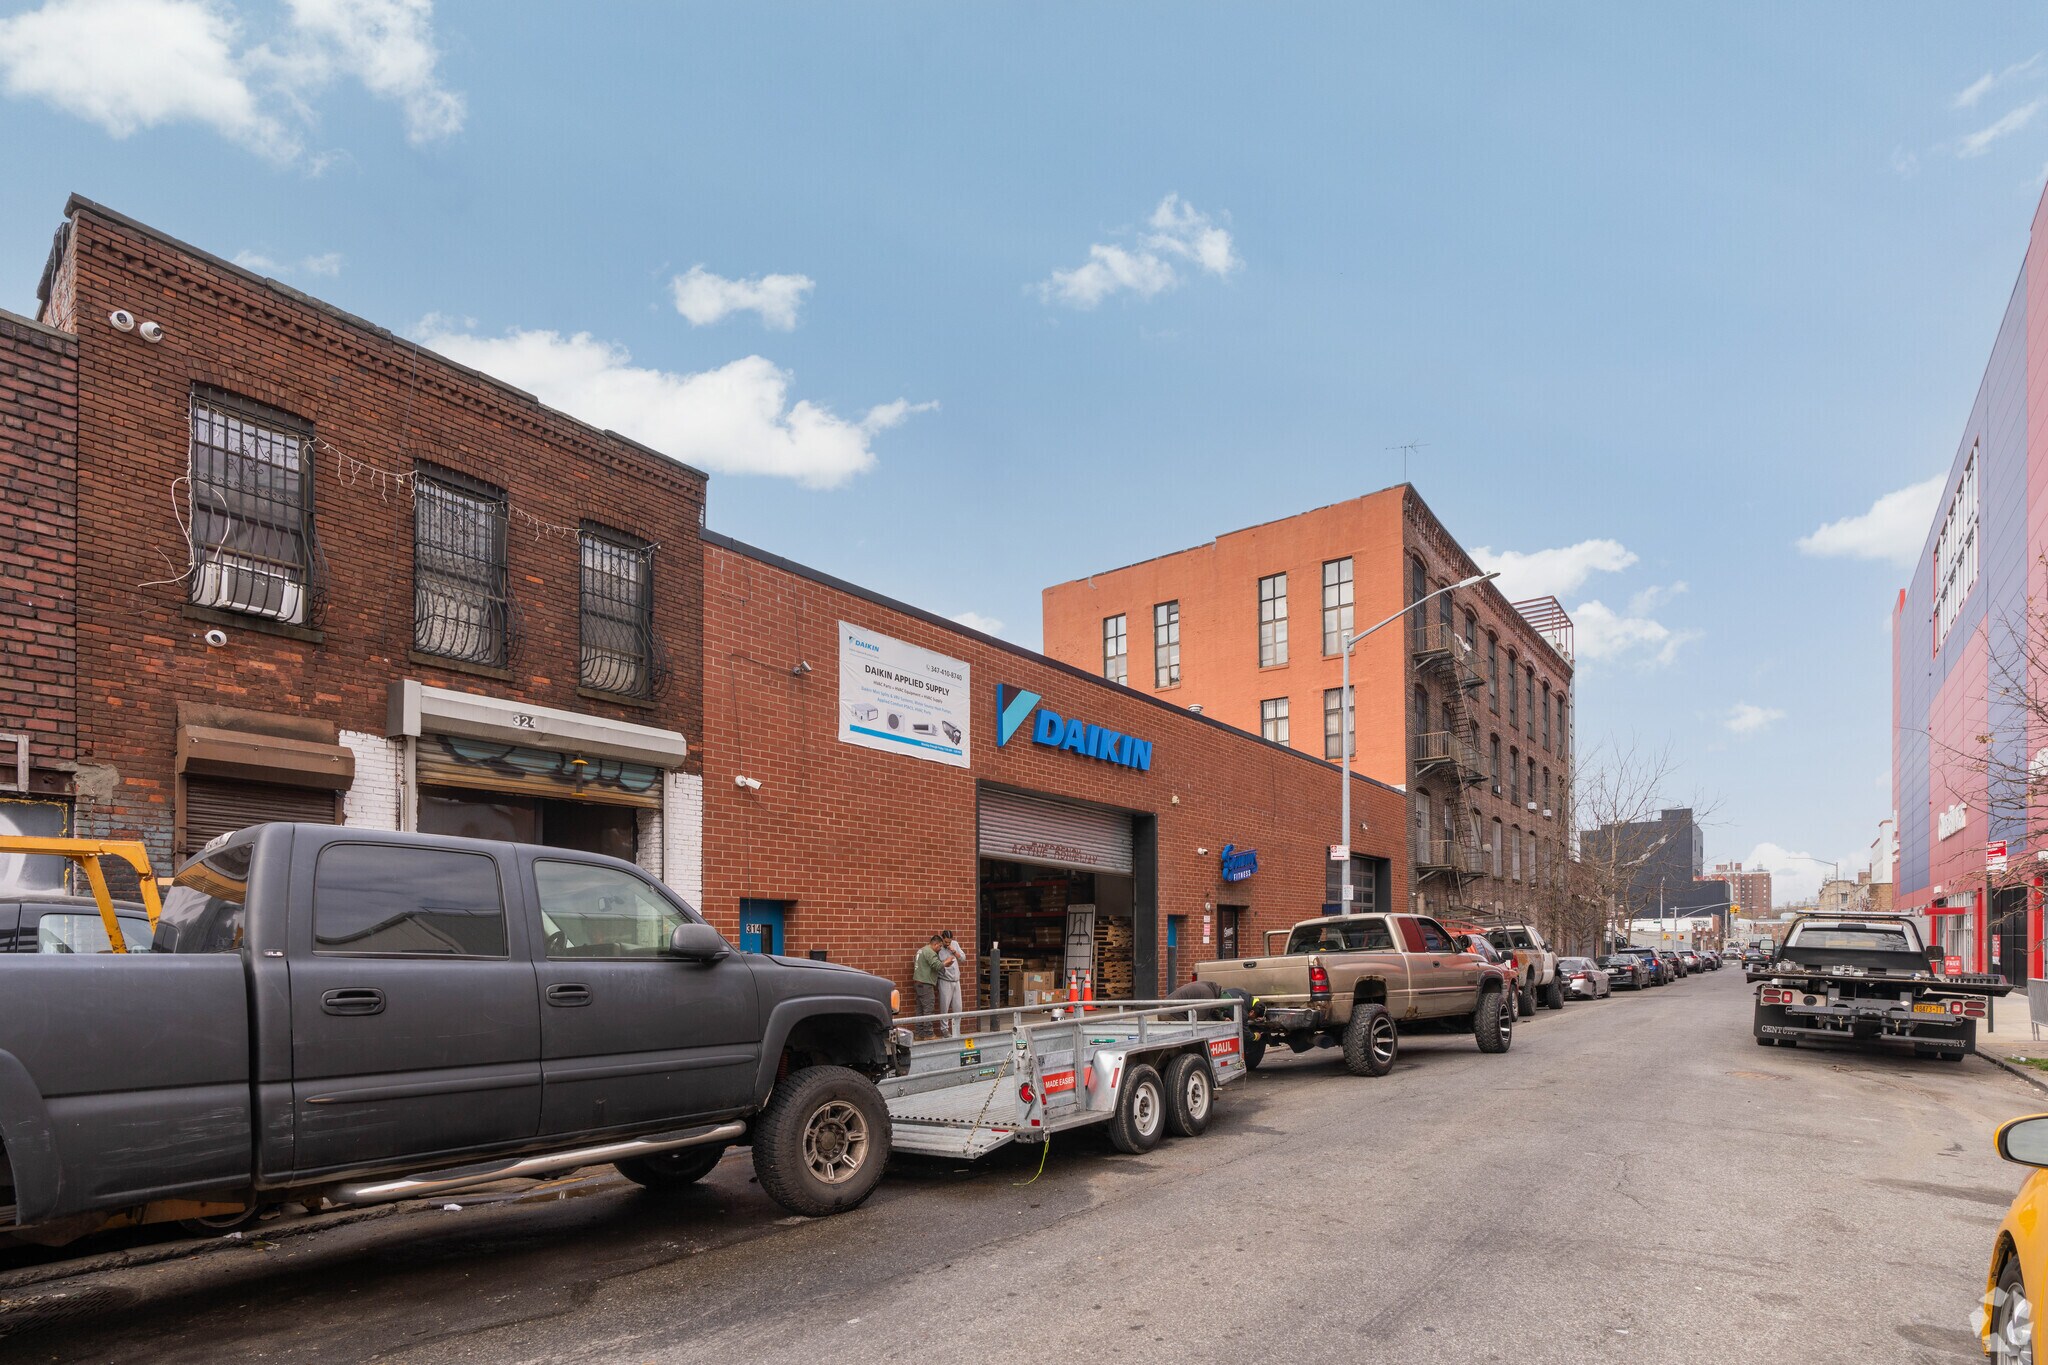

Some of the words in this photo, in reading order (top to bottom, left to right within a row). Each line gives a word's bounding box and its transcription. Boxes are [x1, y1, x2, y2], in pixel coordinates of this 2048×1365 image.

[855, 640, 880, 652] DAIKIN
[931, 666, 962, 681] 347-410-8740
[865, 664, 892, 680] DAIKIN
[894, 673, 923, 688] APPLIED
[925, 682, 949, 696] SUPPLY
[904, 688, 920, 697] Equipment
[513, 715, 536, 728] 324
[1032, 709, 1152, 771] DAIKIN
[1234, 870, 1251, 880] FITNESS
[746, 924, 761, 933] 314
[1762, 1025, 1797, 1035] CENTU
[1060, 1077, 1074, 1086] EASIER
